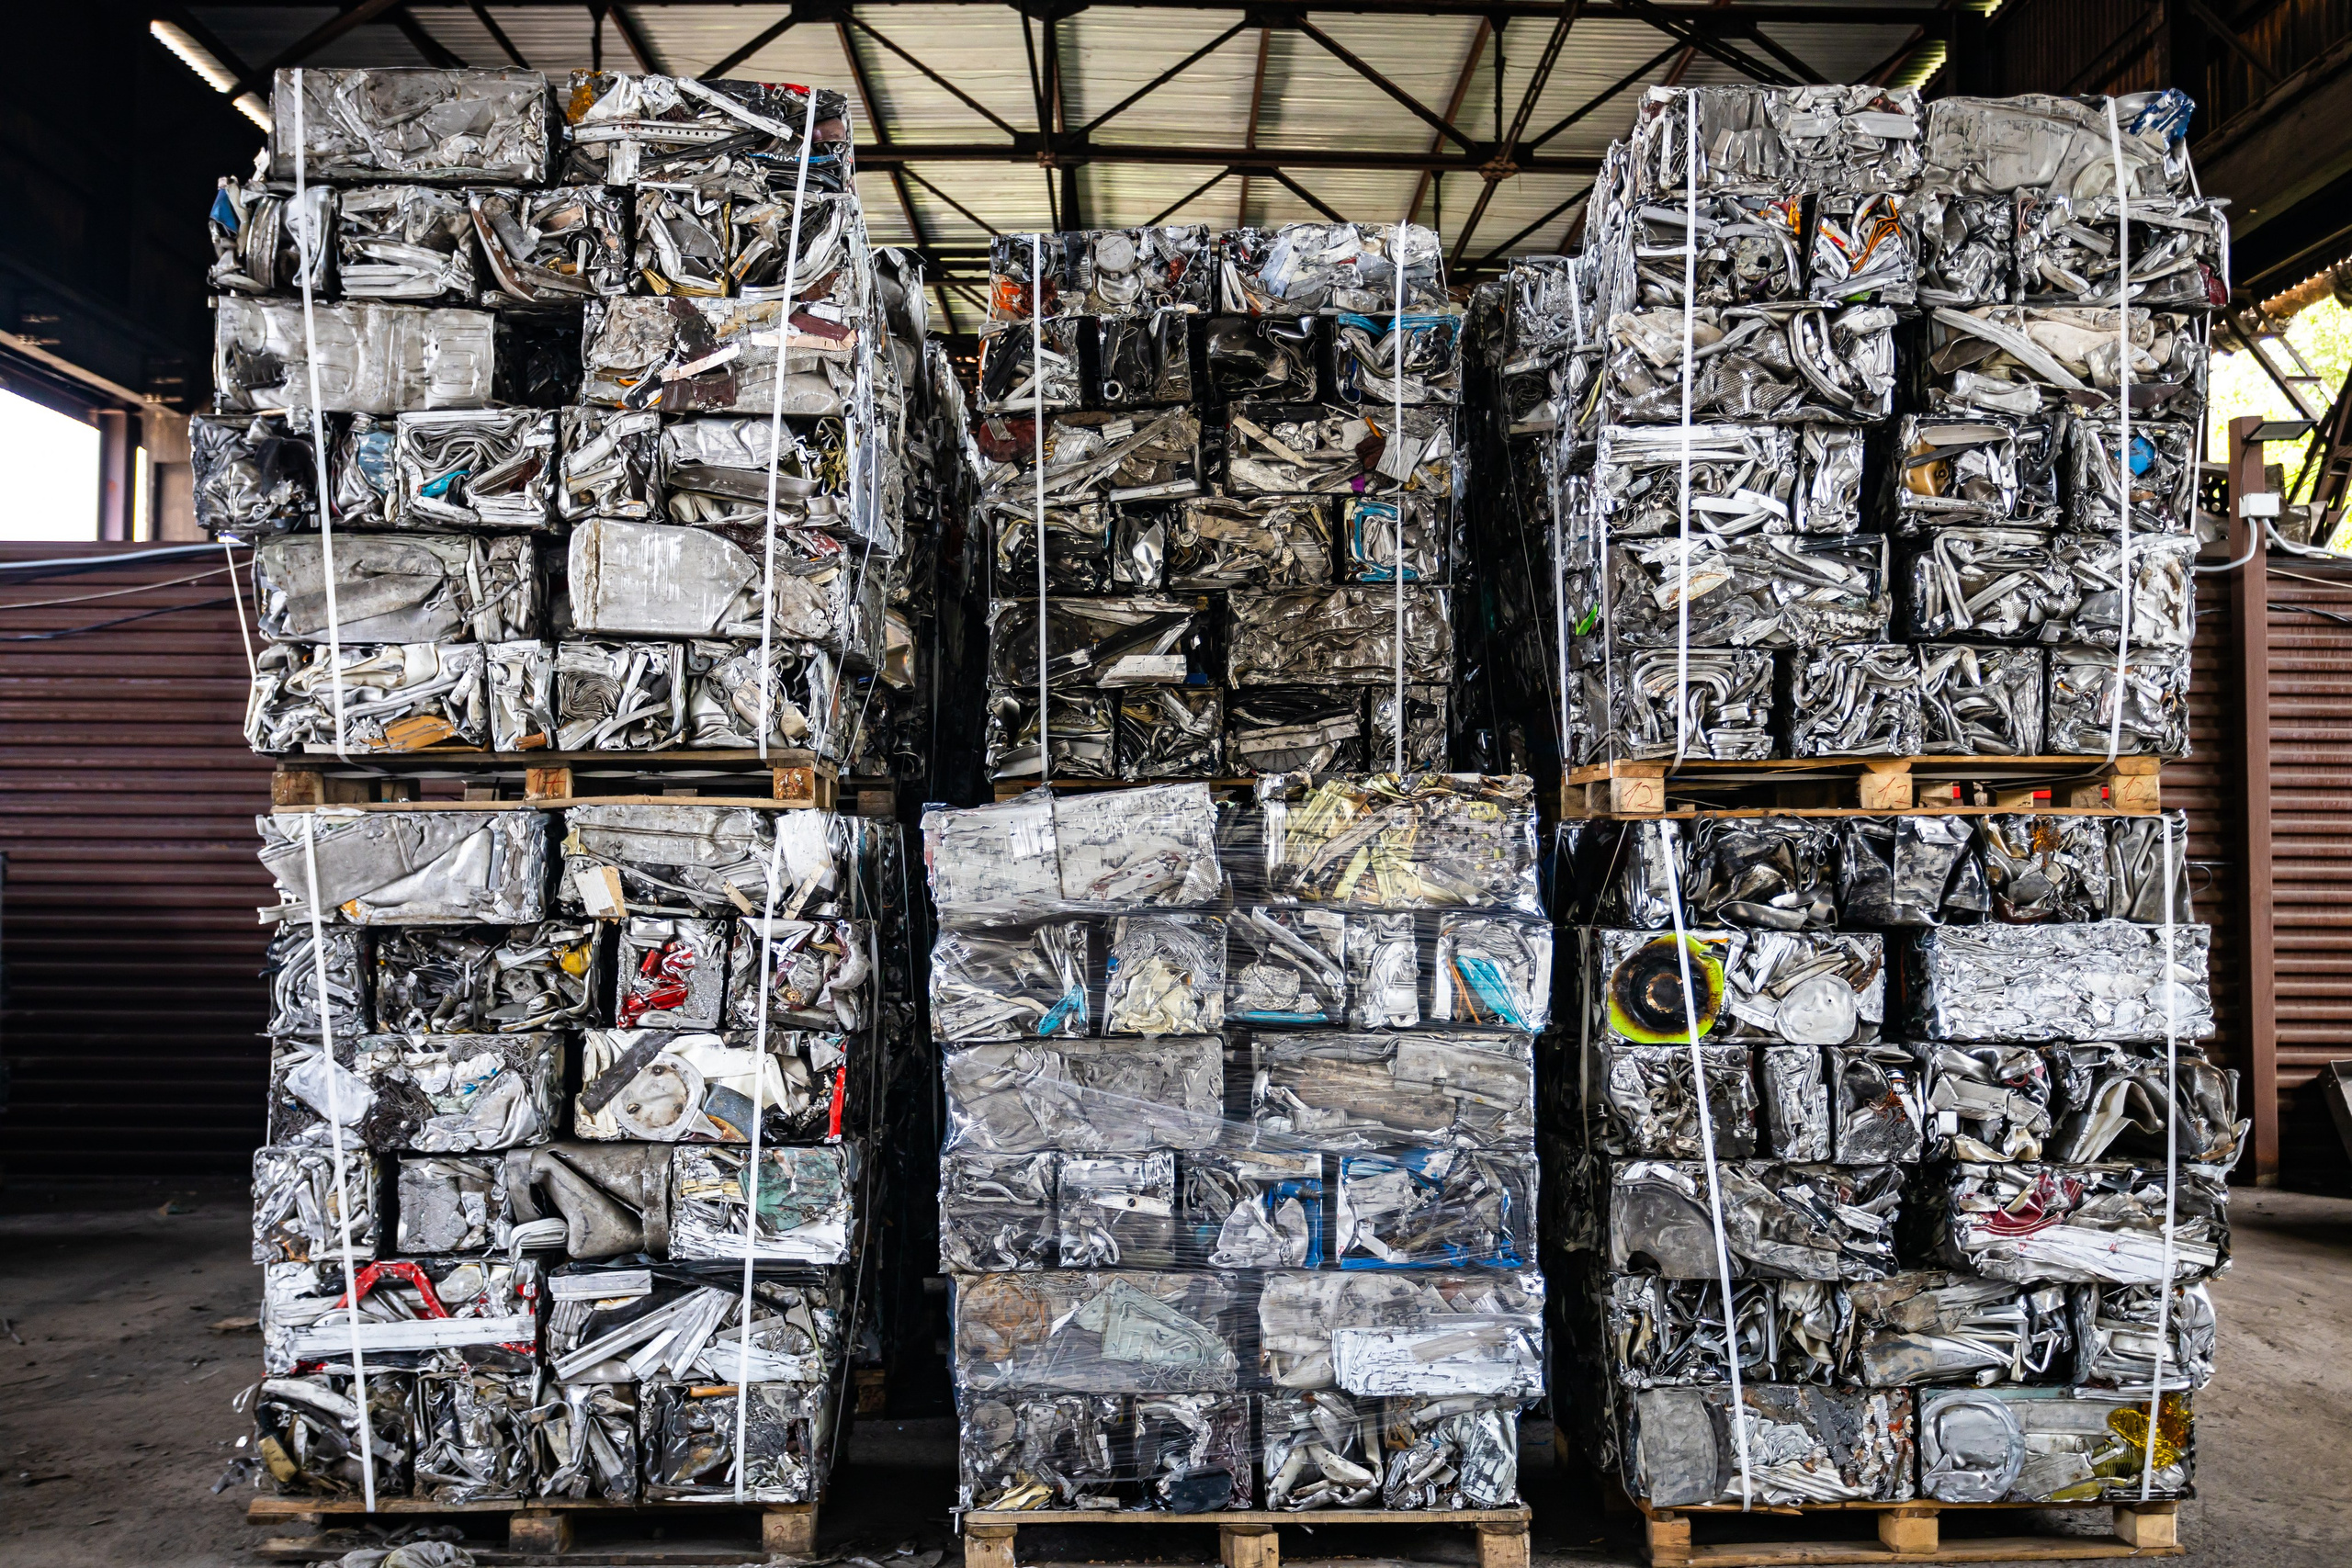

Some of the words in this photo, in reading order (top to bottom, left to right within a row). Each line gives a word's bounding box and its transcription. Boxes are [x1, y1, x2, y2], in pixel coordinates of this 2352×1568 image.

[533, 768, 566, 795] 17
[1623, 781, 1661, 808] 12
[1878, 776, 1911, 804] 12
[2122, 776, 2155, 803] 12
